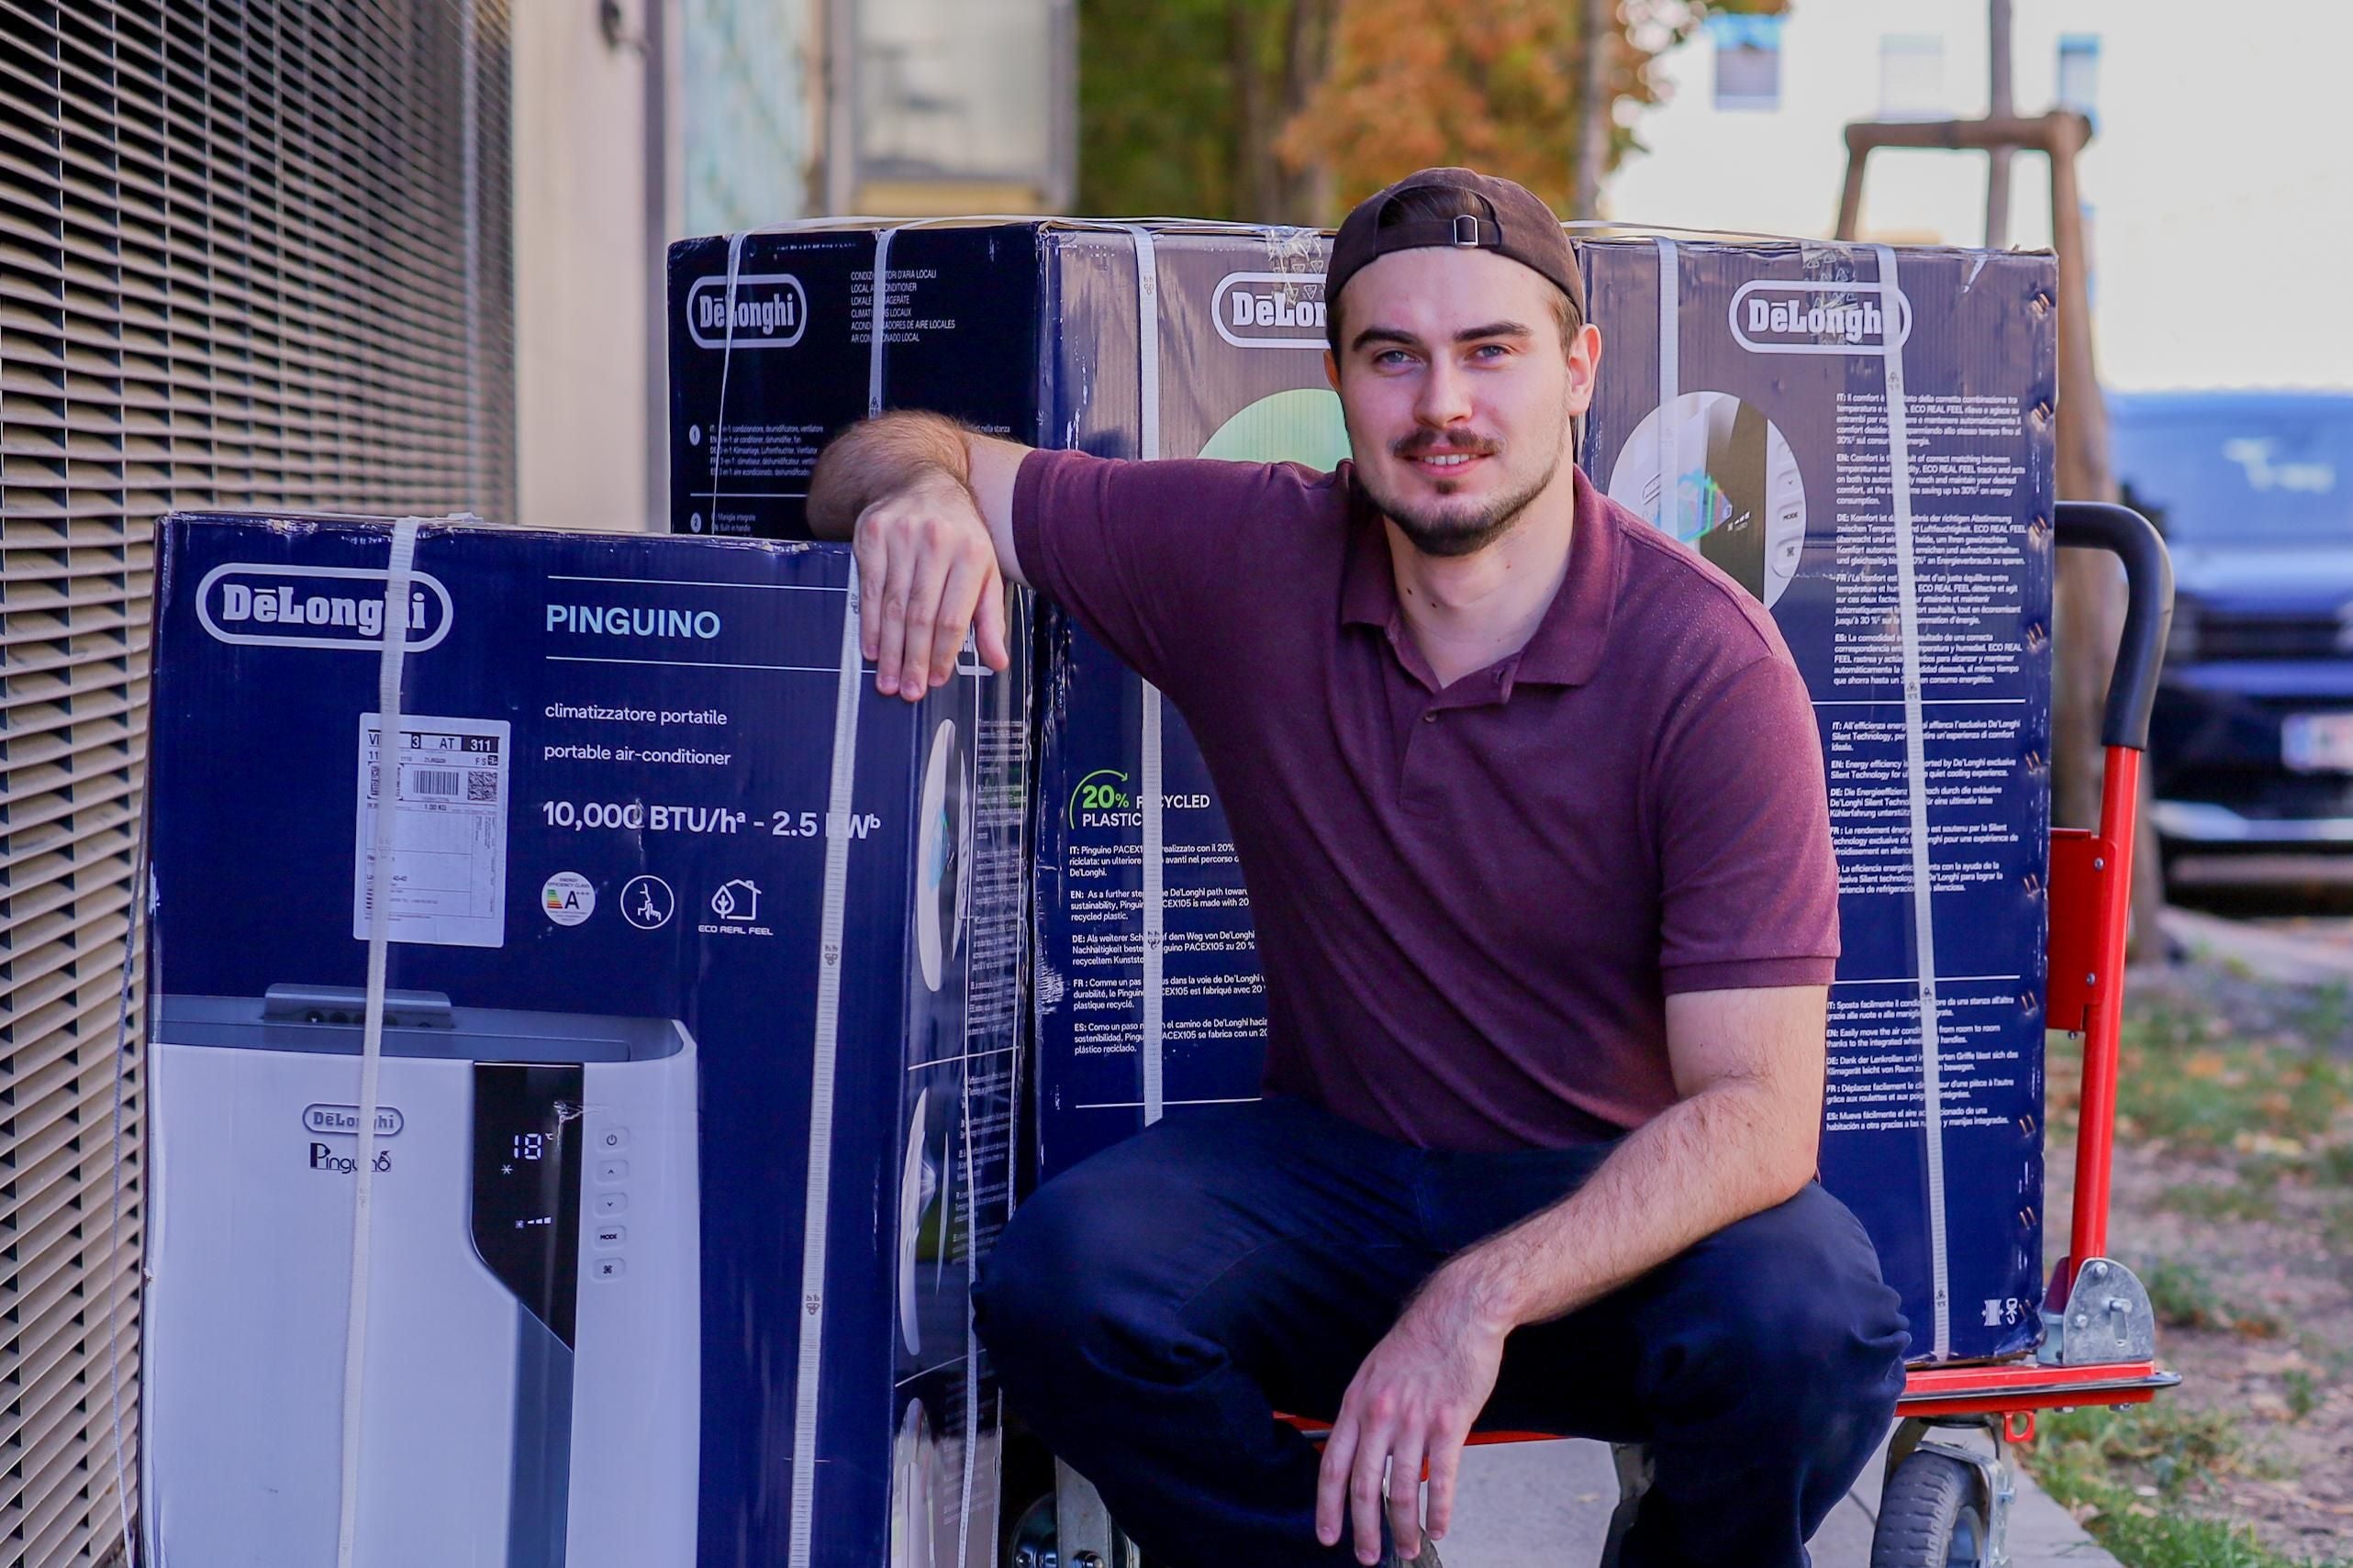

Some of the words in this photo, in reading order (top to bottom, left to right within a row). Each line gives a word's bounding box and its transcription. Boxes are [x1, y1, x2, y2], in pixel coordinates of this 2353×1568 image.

[930, 319, 955, 328] LOCALES
[1748, 299, 1882, 343] DēLongh
[1927, 406, 1946, 414] REAL
[1946, 406, 1964, 414] FEEL
[1939, 465, 1957, 473] REAL
[1958, 465, 1976, 473] FEEL
[1974, 525, 1989, 533] ECO
[1991, 525, 2009, 533] REAL
[2010, 525, 2026, 533] FEEL
[1918, 584, 1933, 593] ECO
[1935, 584, 1952, 593] REAL
[1954, 584, 1970, 593] FEEL
[546, 605, 720, 639] PINGUINO
[545, 703, 656, 722] climatizzatore
[661, 708, 728, 726] portatile
[412, 736, 419, 748] 3
[440, 738, 455, 749] AT
[470, 739, 491, 751] 311
[544, 744, 611, 761] portable
[616, 748, 731, 765] air-conditioner
[1851, 771, 1890, 780] Technology
[1082, 784, 1130, 808] 20%
[1136, 795, 1210, 808] RYCLED
[543, 800, 642, 831] 10,000
[772, 811, 818, 837] 2.5
[1082, 812, 1143, 827] PLASTIC
[1070, 846, 1079, 854] IT:
[1081, 846, 1111, 856] Pinguino
[1218, 843, 1234, 851] 20%
[1069, 857, 1099, 865] riciclata:
[1112, 856, 1142, 864] ulteriore
[1165, 855, 1187, 863] avanti
[1188, 855, 1199, 863] nel
[1201, 856, 1232, 864] percorso
[1207, 888, 1222, 897] path
[1222, 898, 1237, 906] with
[1071, 912, 1101, 922] recycled
[1104, 912, 1128, 921] plastic.
[697, 924, 718, 933] ECO
[719, 925, 746, 935] REAL
[748, 926, 774, 936] FEEL
[1099, 934, 1128, 942] weiterer
[1169, 932, 1185, 940] dem
[1187, 932, 1203, 941] Weg
[1073, 945, 1121, 955] Nachhaltigkeit
[1073, 957, 1112, 967] recyceltem
[1074, 979, 1083, 987] FR
[1170, 976, 1187, 984] dans
[1213, 975, 1222, 984] de
[1203, 986, 1232, 996] fabriqué
[1074, 1001, 1105, 1011] plastique
[1107, 1000, 1134, 1010] recyclé.
[1088, 1023, 1110, 1031] Como
[1121, 1023, 1138, 1031] paso
[1167, 1020, 1174, 1029] el
[1209, 1029, 1233, 1038] fabrica
[1075, 1045, 1101, 1055] plástico
[514, 1133, 542, 1161] 18
